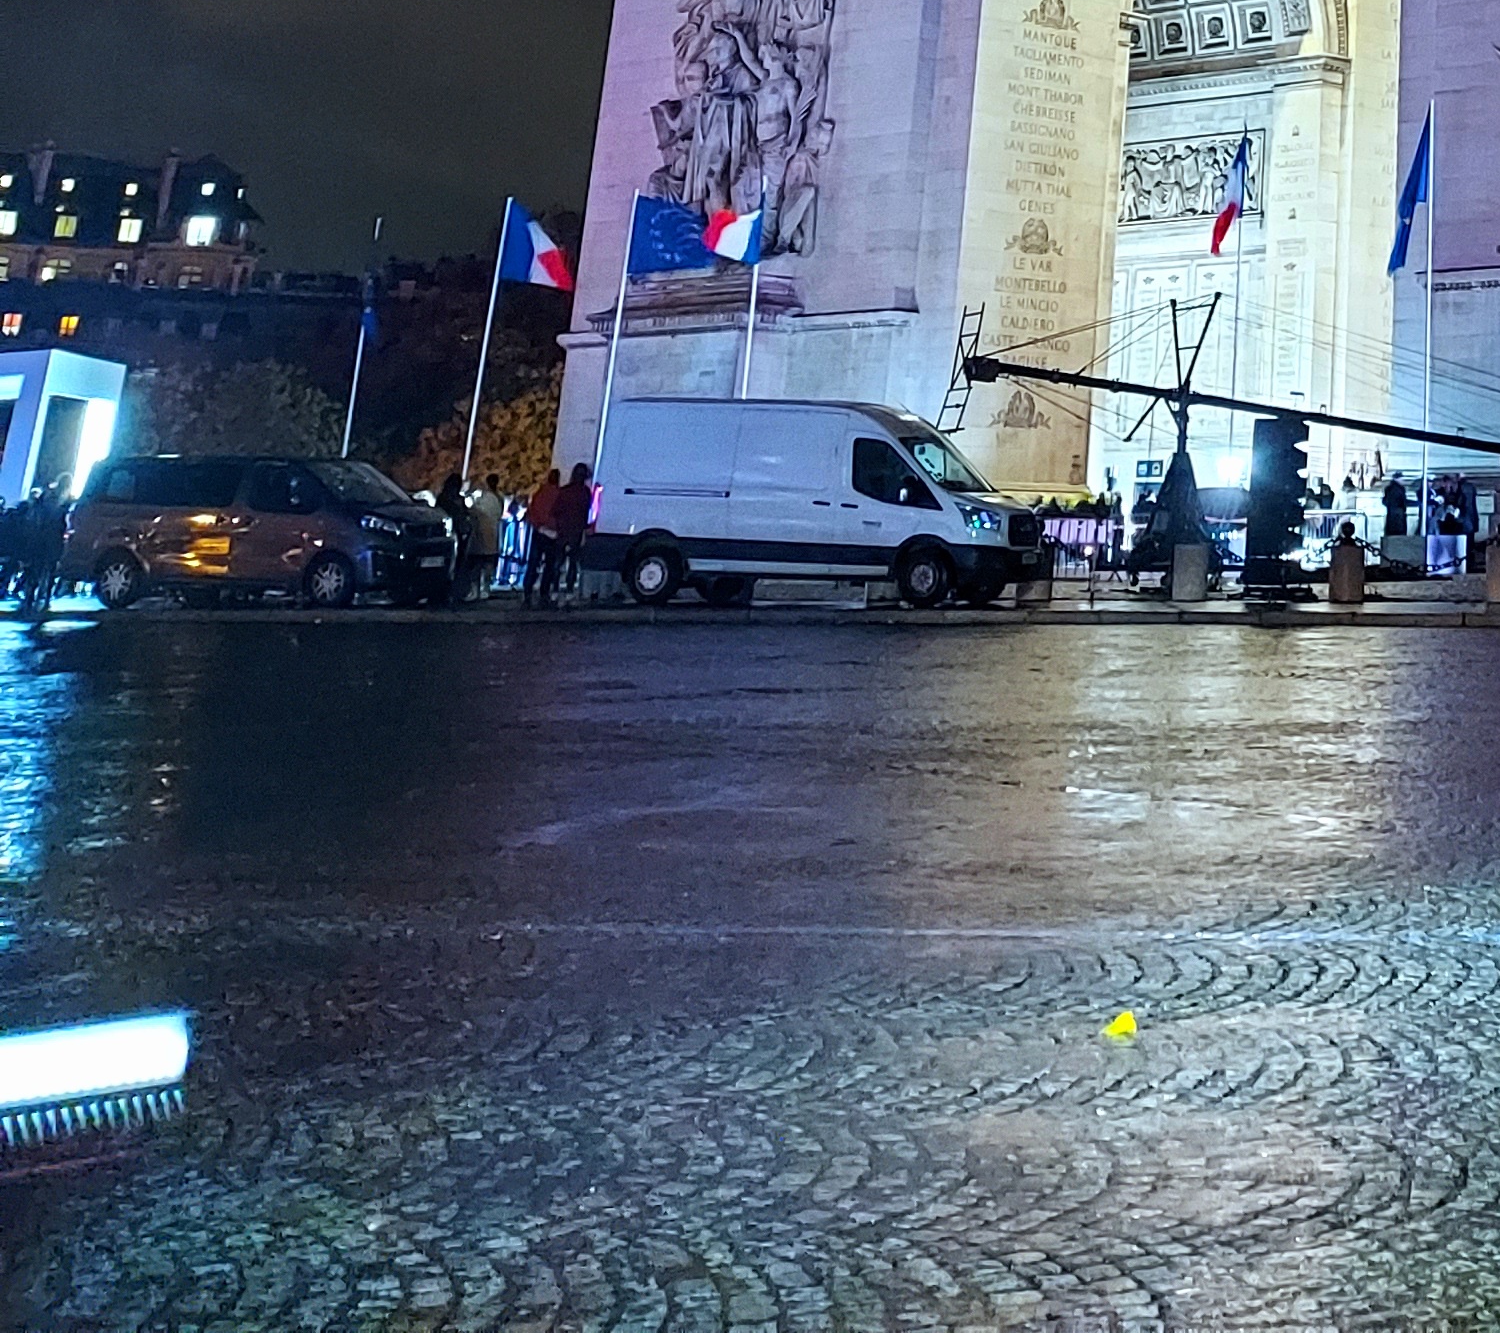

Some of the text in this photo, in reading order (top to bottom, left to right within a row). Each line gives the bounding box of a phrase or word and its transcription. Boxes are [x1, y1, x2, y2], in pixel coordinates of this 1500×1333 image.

[1022, 28, 1077, 51] MANTOUE
[1013, 45, 1084, 69] TAGLIAMENTO
[1024, 66, 1071, 86] SEDIMAN
[1007, 83, 1084, 106] MONT THABOR
[1010, 120, 1076, 142] BASSIGNANO
[1004, 139, 1080, 161] SAN GIULIANO
[1005, 178, 1072, 198] MUTTA THAL
[1019, 199, 1056, 215] GENES
[1013, 256, 1053, 273] LE VAR
[994, 275, 1068, 294] MONTEBELLO
[1000, 295, 1059, 313] LE MINCIO
[1001, 315, 1055, 332] CALDIERO
